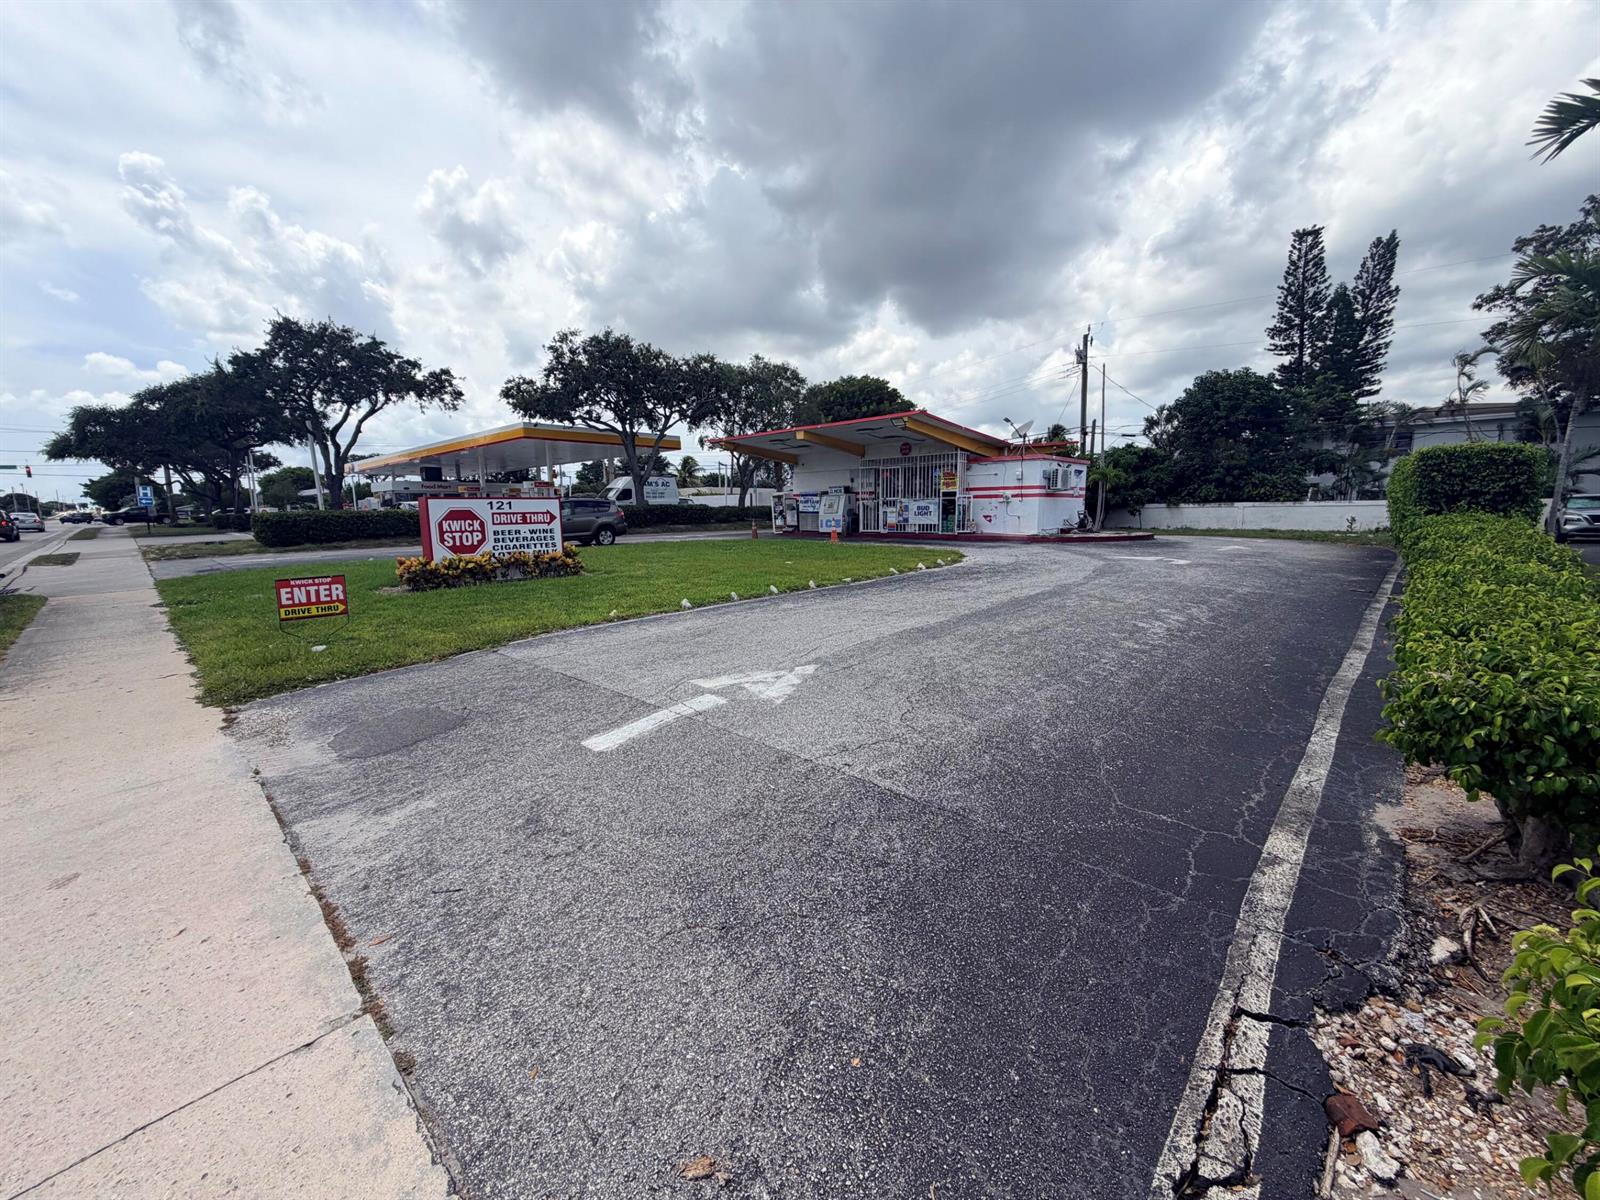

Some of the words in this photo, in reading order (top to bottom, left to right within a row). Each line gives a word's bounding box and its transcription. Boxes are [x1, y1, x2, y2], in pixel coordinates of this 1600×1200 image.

[139, 486, 151, 497] H
[487, 501, 512, 510] 121
[493, 513, 523, 524] DRIVE
[525, 512, 551, 523] THRU
[442, 520, 481, 532] KWICK
[443, 532, 482, 546] STOP
[493, 535, 556, 544] BEVERAGES
[492, 541, 557, 551] CIGARETTES
[280, 584, 344, 605] ENTER
[284, 607, 313, 616] DRIVE
[315, 604, 339, 613] THRU
